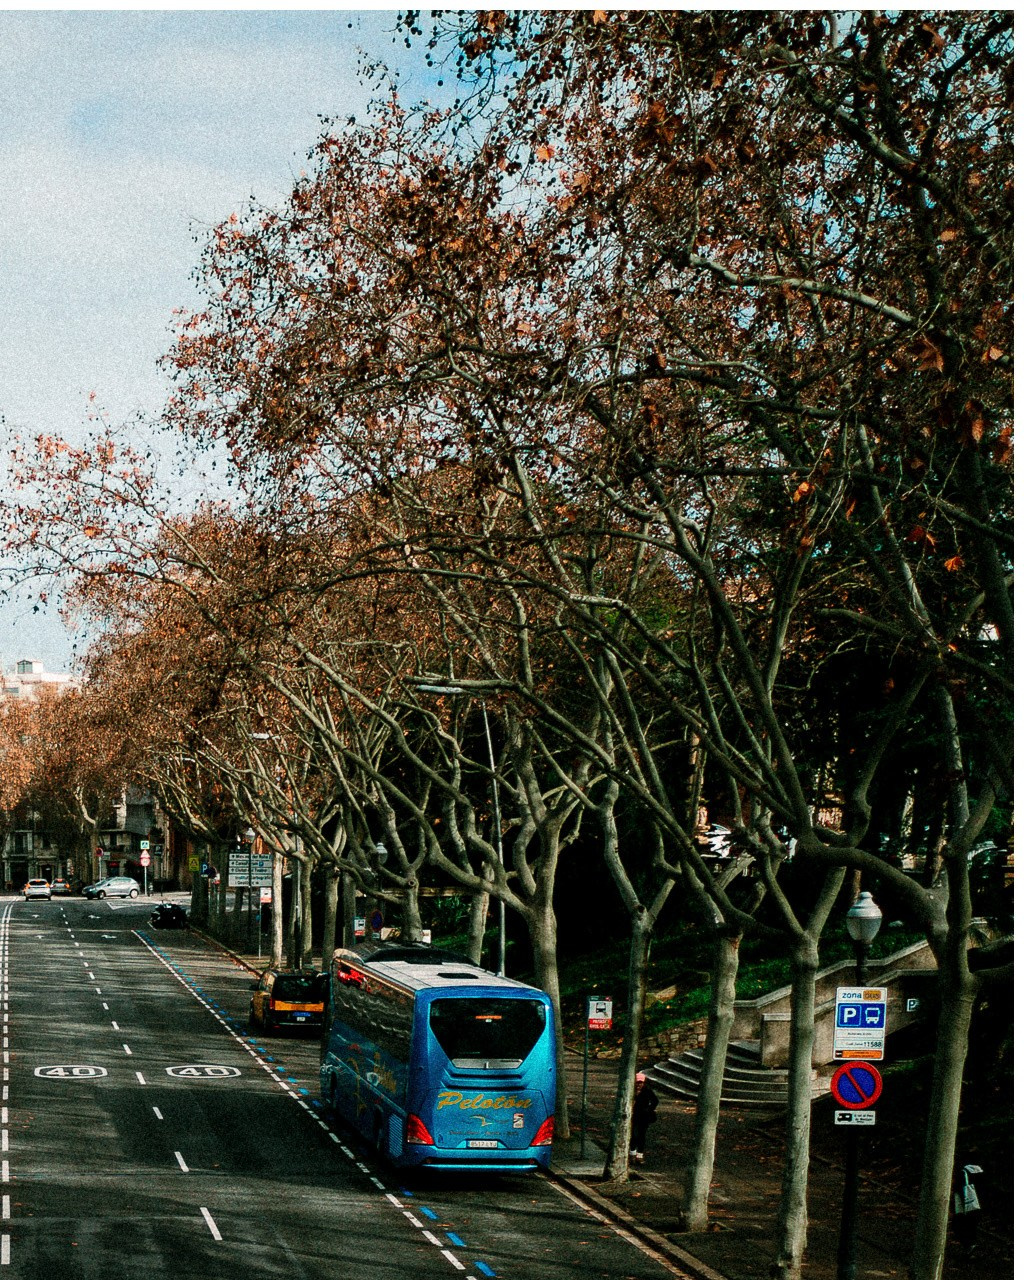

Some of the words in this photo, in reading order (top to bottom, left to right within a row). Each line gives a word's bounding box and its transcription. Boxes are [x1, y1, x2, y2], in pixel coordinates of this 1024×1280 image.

[843, 1007, 857, 1023] P
[46, 1067, 96, 1077] 40
[179, 1067, 229, 1076] 40
